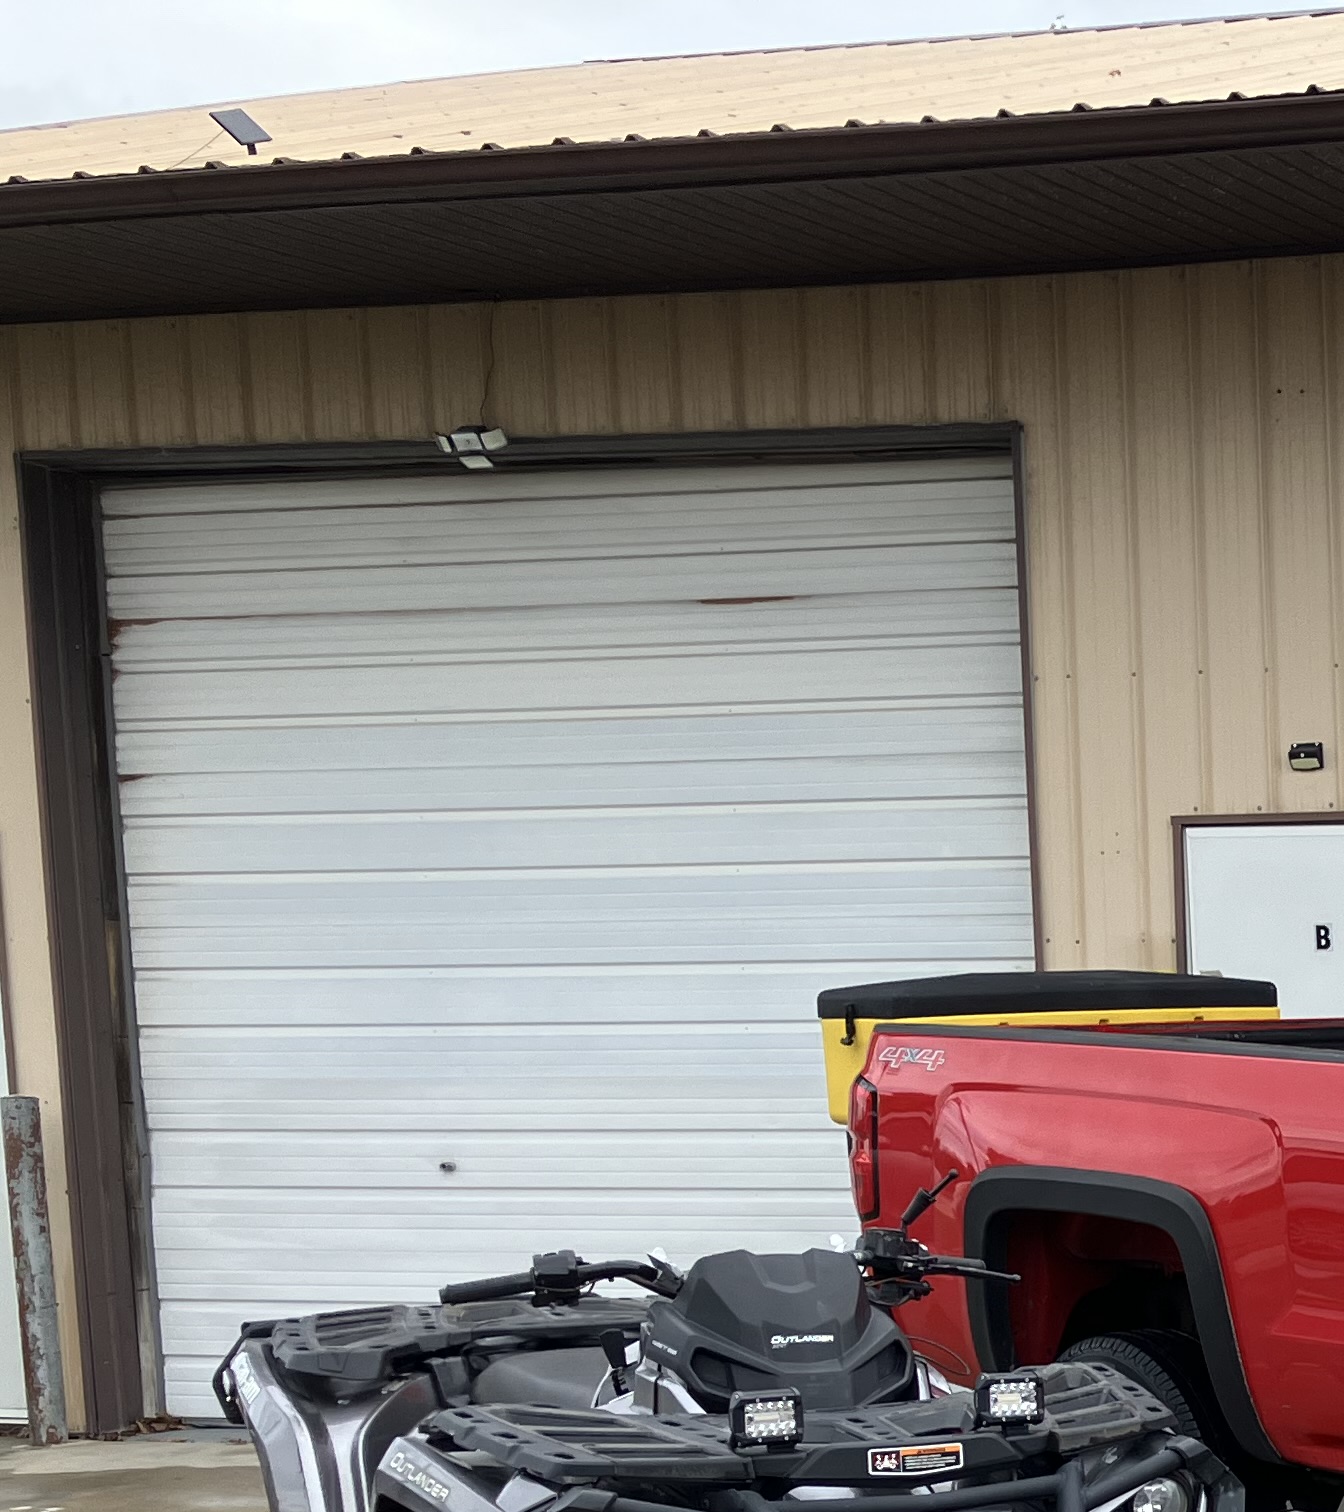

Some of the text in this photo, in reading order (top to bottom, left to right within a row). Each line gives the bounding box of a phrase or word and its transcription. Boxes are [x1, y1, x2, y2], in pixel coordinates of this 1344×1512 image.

[1315, 924, 1331, 950] B
[770, 1334, 834, 1345] OUTLANDER
[390, 1452, 450, 1502] OUTLANDER
